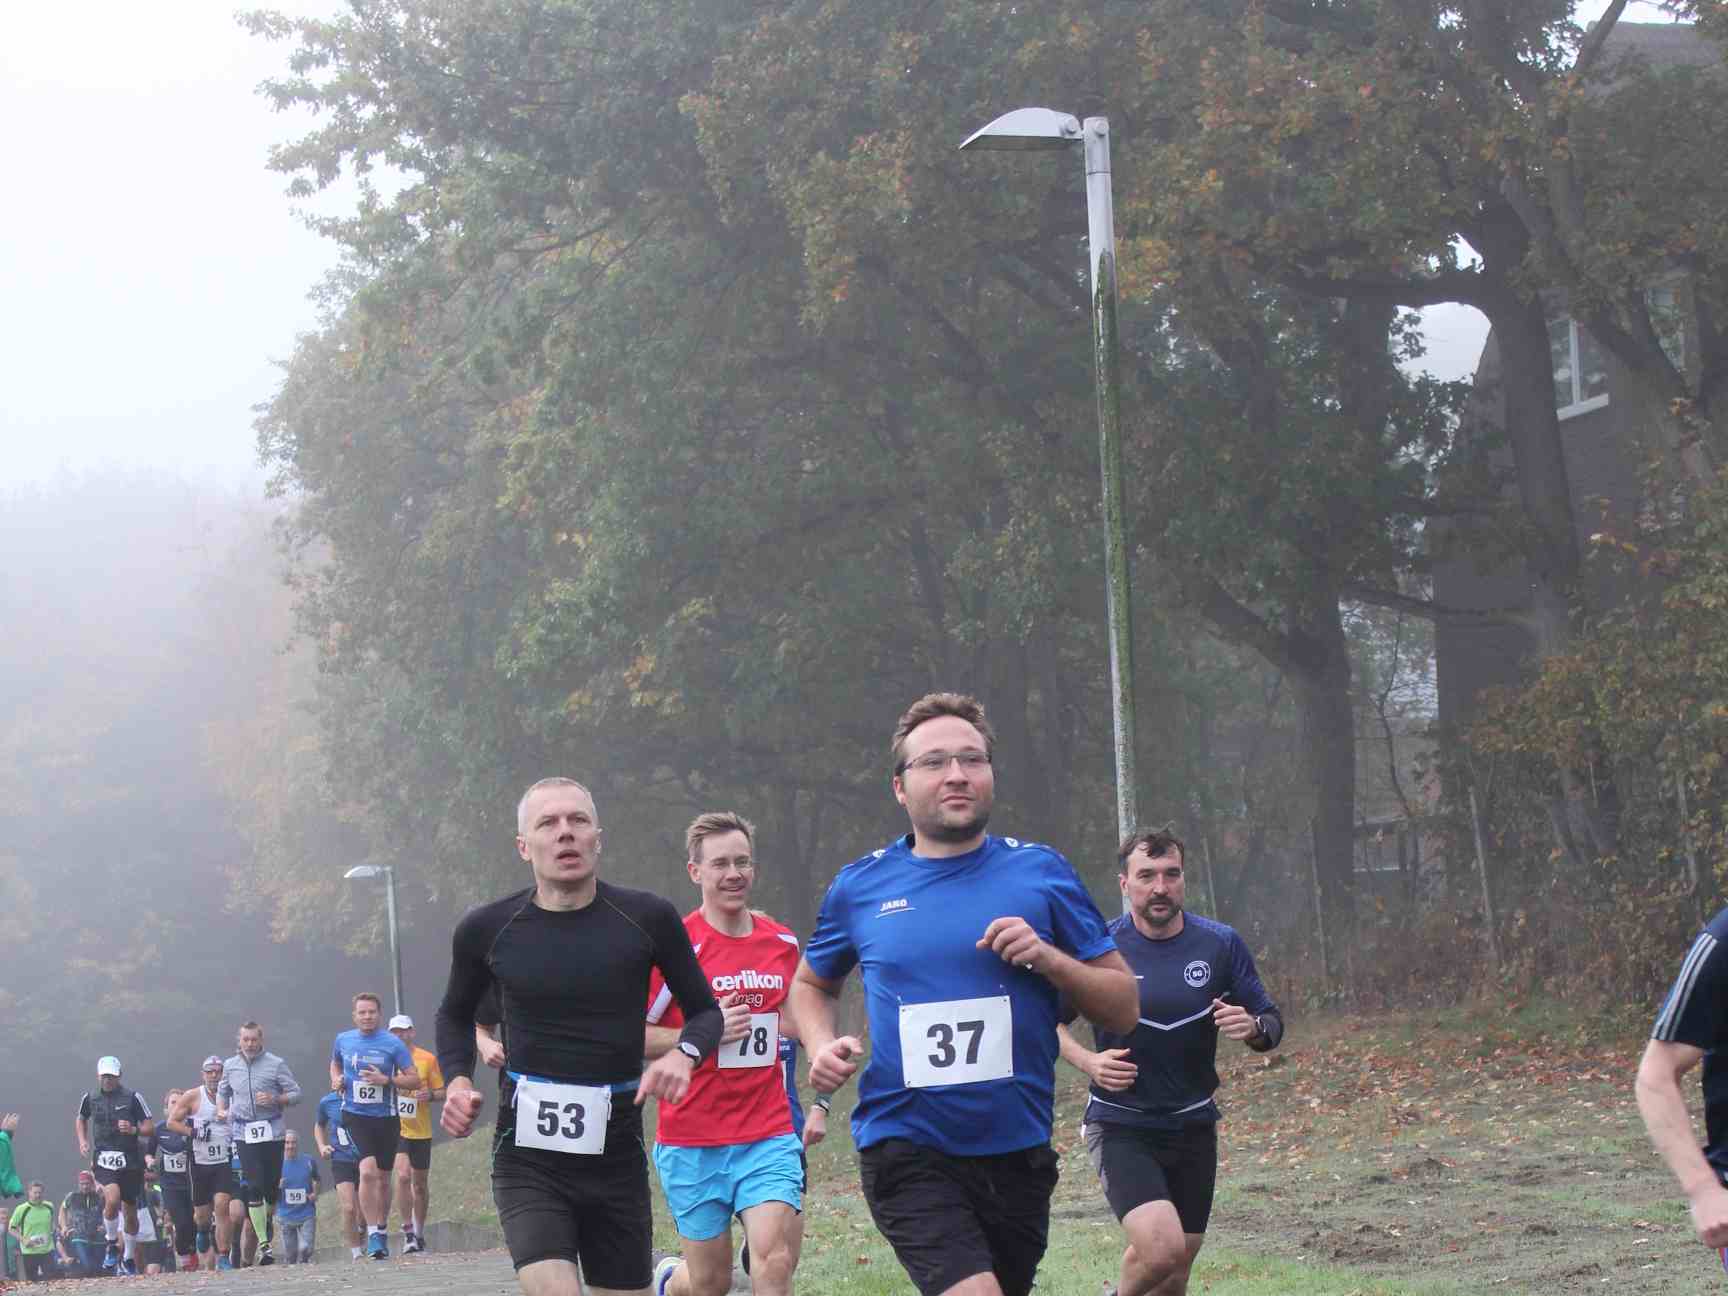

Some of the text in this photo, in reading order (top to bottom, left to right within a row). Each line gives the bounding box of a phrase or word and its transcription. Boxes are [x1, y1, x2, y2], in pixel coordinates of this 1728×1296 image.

[880, 898, 908, 911] JAKO
[926, 1020, 985, 1068] 37
[359, 1087, 376, 1099] 62
[400, 1102, 415, 1114] 20
[537, 1100, 585, 1139] 53
[250, 1126, 265, 1138] 97
[207, 1145, 222, 1157] 91
[102, 1155, 123, 1167] 126
